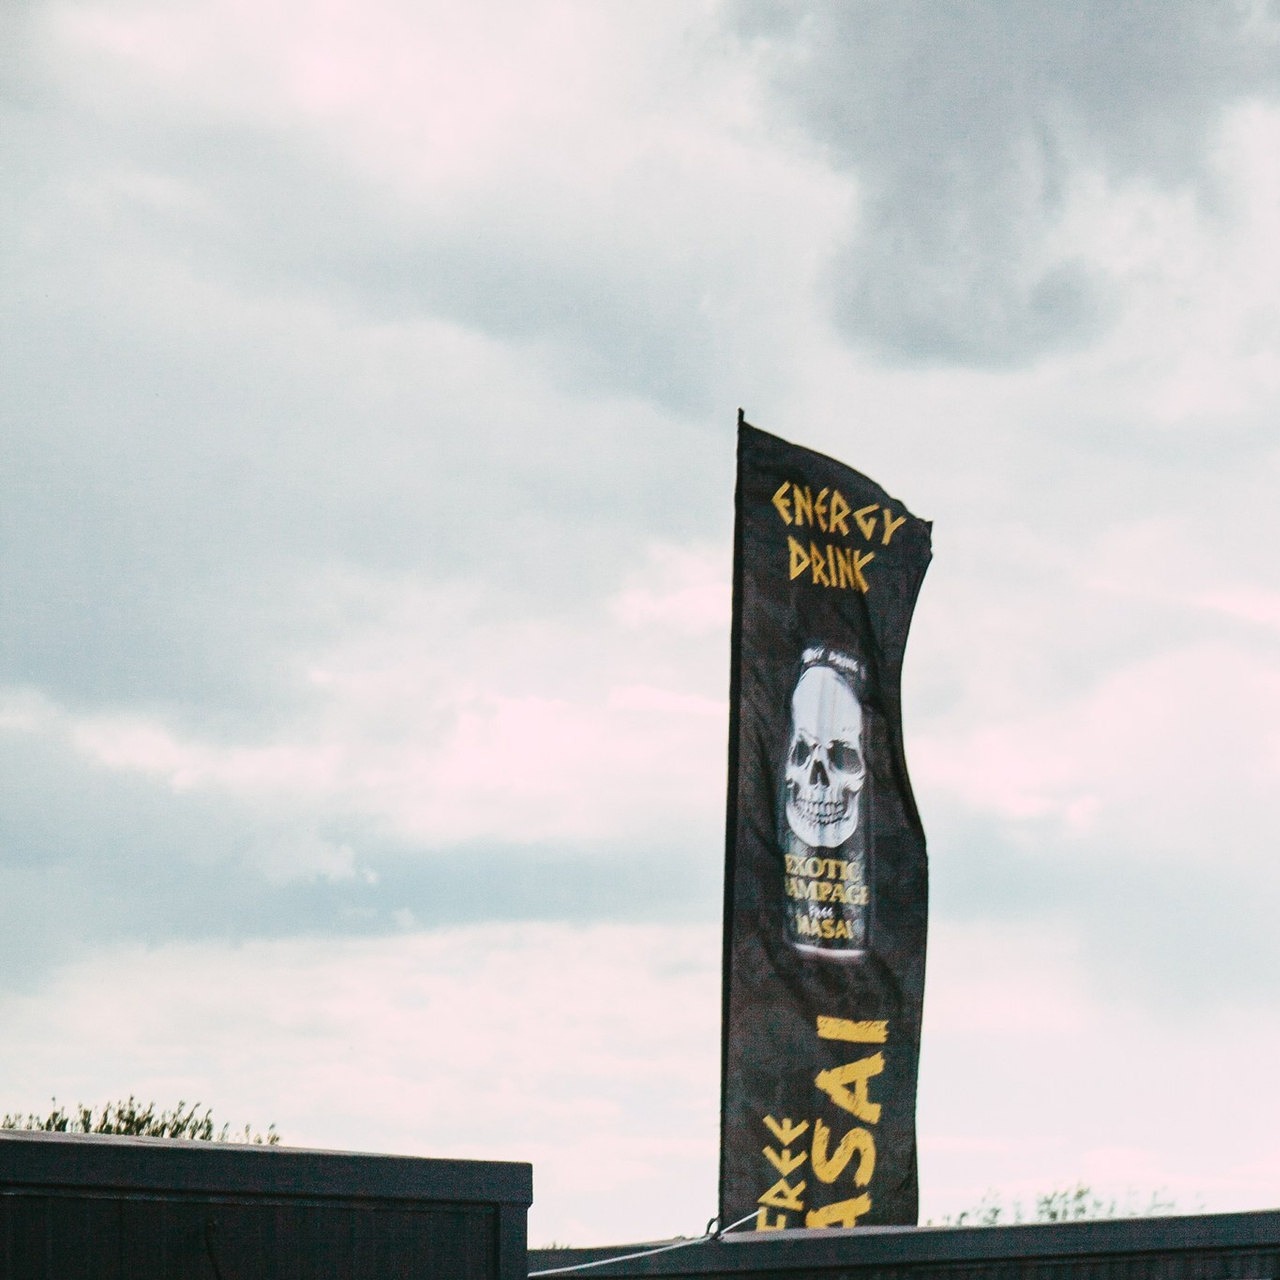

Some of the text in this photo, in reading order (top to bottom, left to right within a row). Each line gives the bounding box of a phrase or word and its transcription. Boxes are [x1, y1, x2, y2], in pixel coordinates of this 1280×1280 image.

[771, 481, 907, 546] ENERGY
[787, 535, 876, 595] DRINK
[784, 853, 863, 882] EXOTIC
